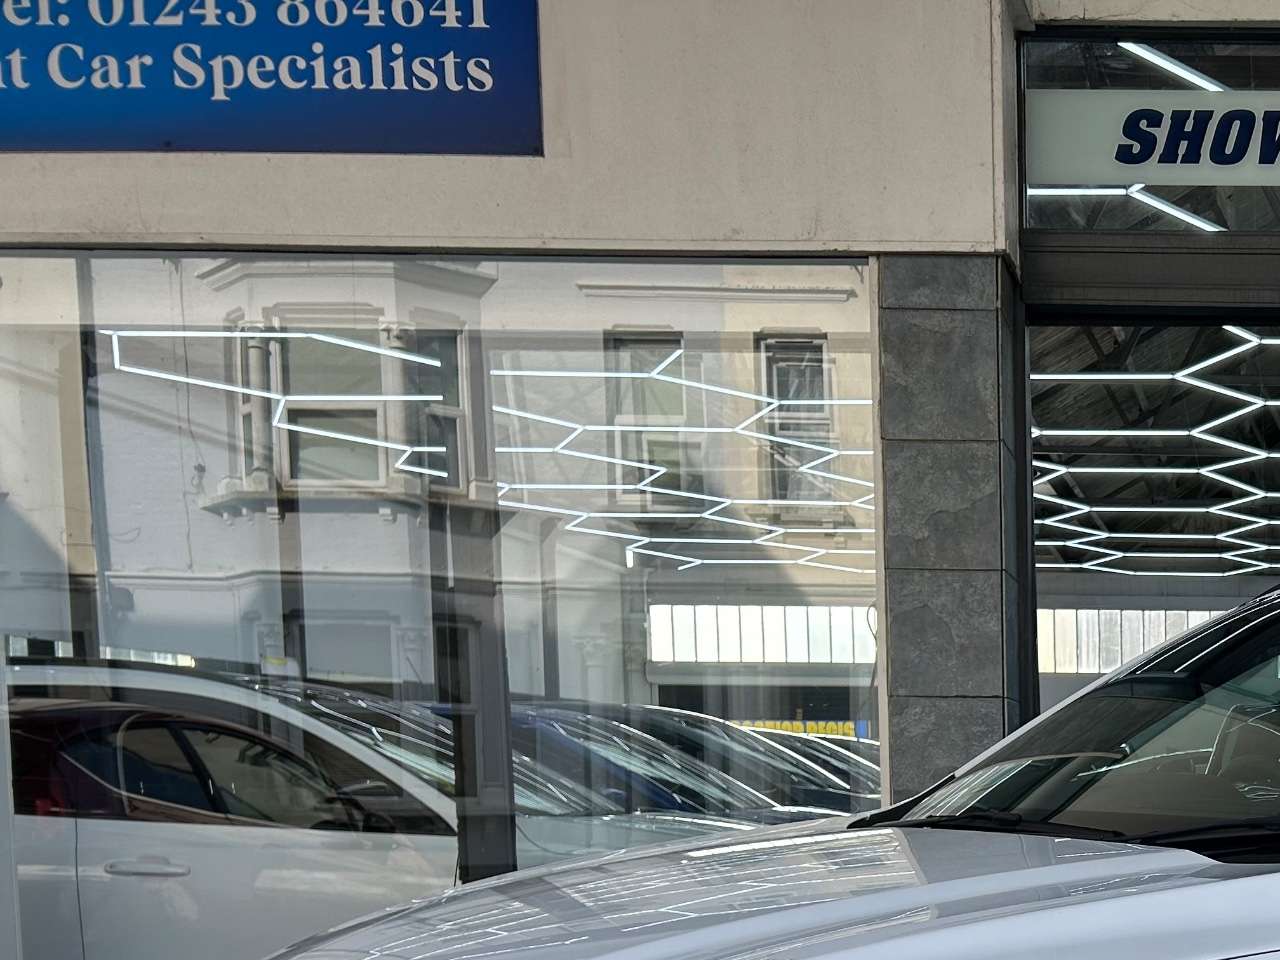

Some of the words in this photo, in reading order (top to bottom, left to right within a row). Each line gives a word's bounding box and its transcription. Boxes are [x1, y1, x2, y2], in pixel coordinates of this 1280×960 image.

[87, 0, 257, 27] 01243
[276, 0, 491, 28] 864641
[0, 47, 32, 89] t
[47, 42, 154, 89] Car
[172, 41, 494, 102] Specialists
